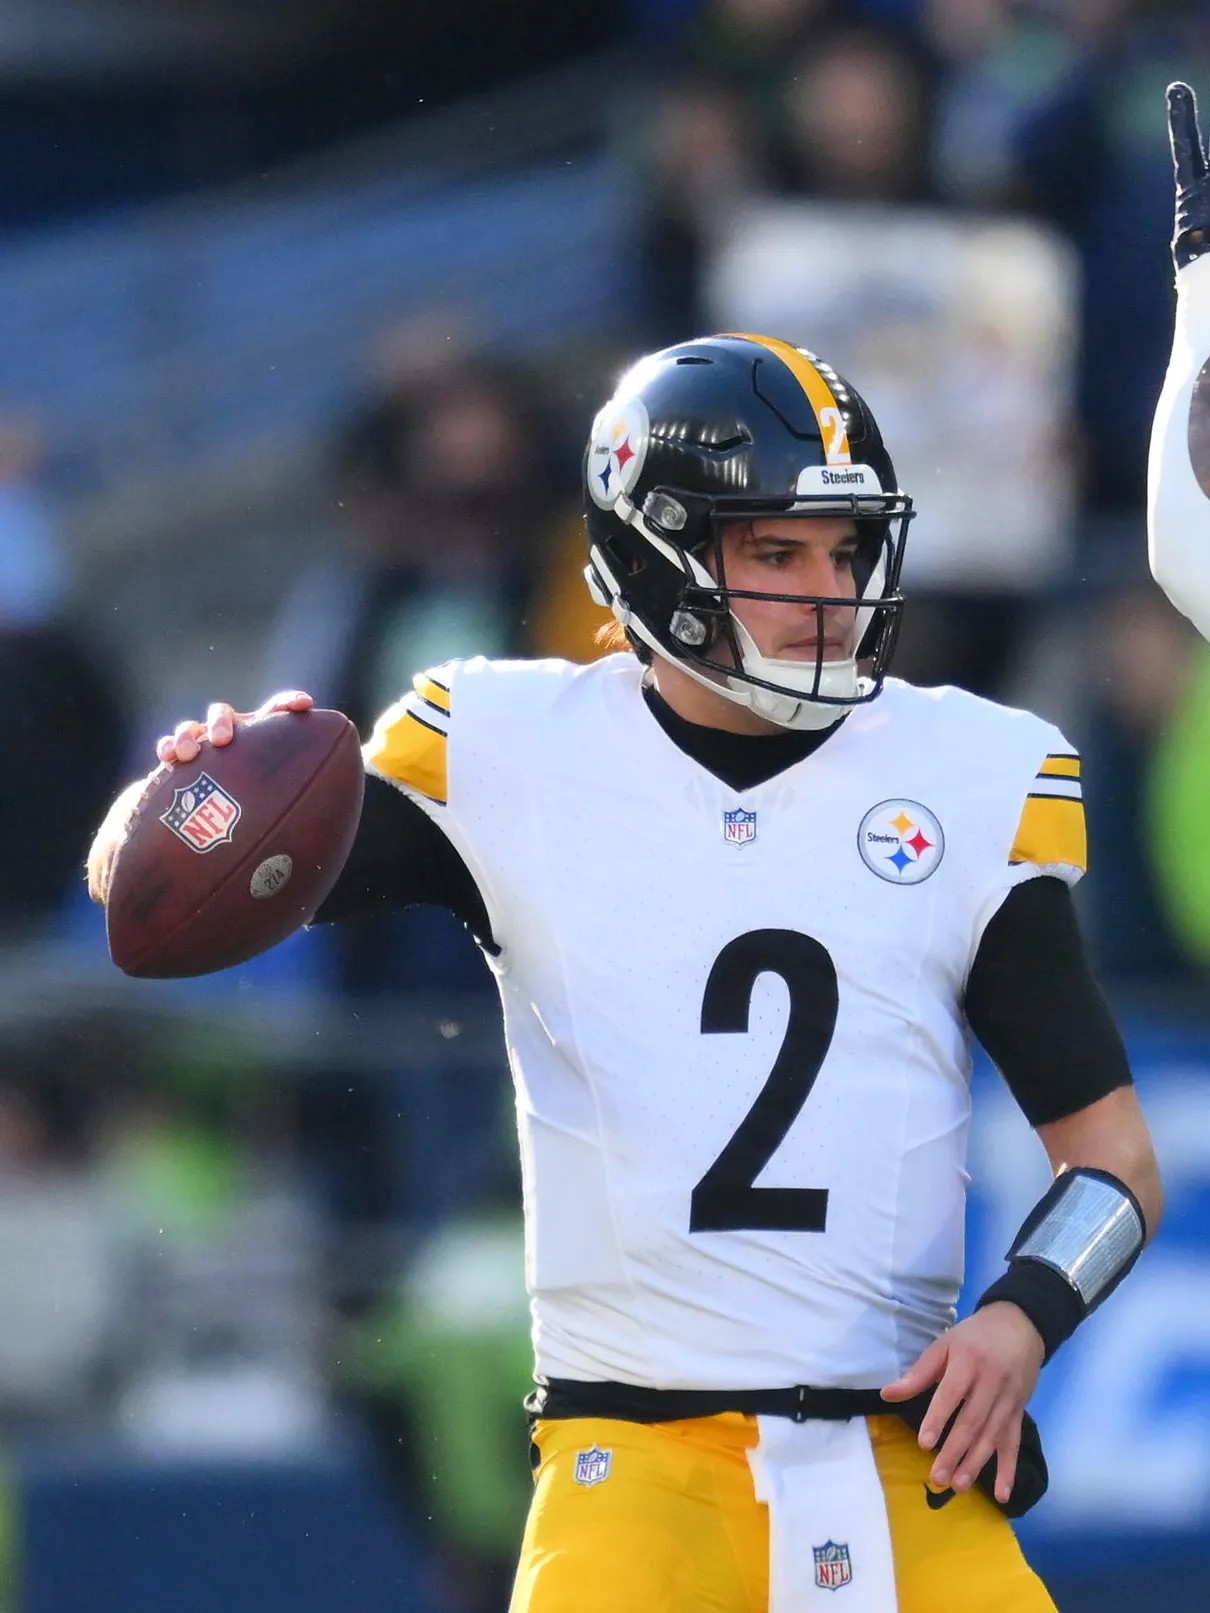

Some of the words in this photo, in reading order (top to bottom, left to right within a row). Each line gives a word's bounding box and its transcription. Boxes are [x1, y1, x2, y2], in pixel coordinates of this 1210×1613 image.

[820, 407, 851, 464] 2
[821, 469, 865, 484] Steelers
[182, 797, 235, 846] NFL
[727, 823, 754, 841] NFL
[688, 927, 840, 1235] 2
[579, 1462, 604, 1479] NFL
[817, 1563, 849, 1586] NFL
